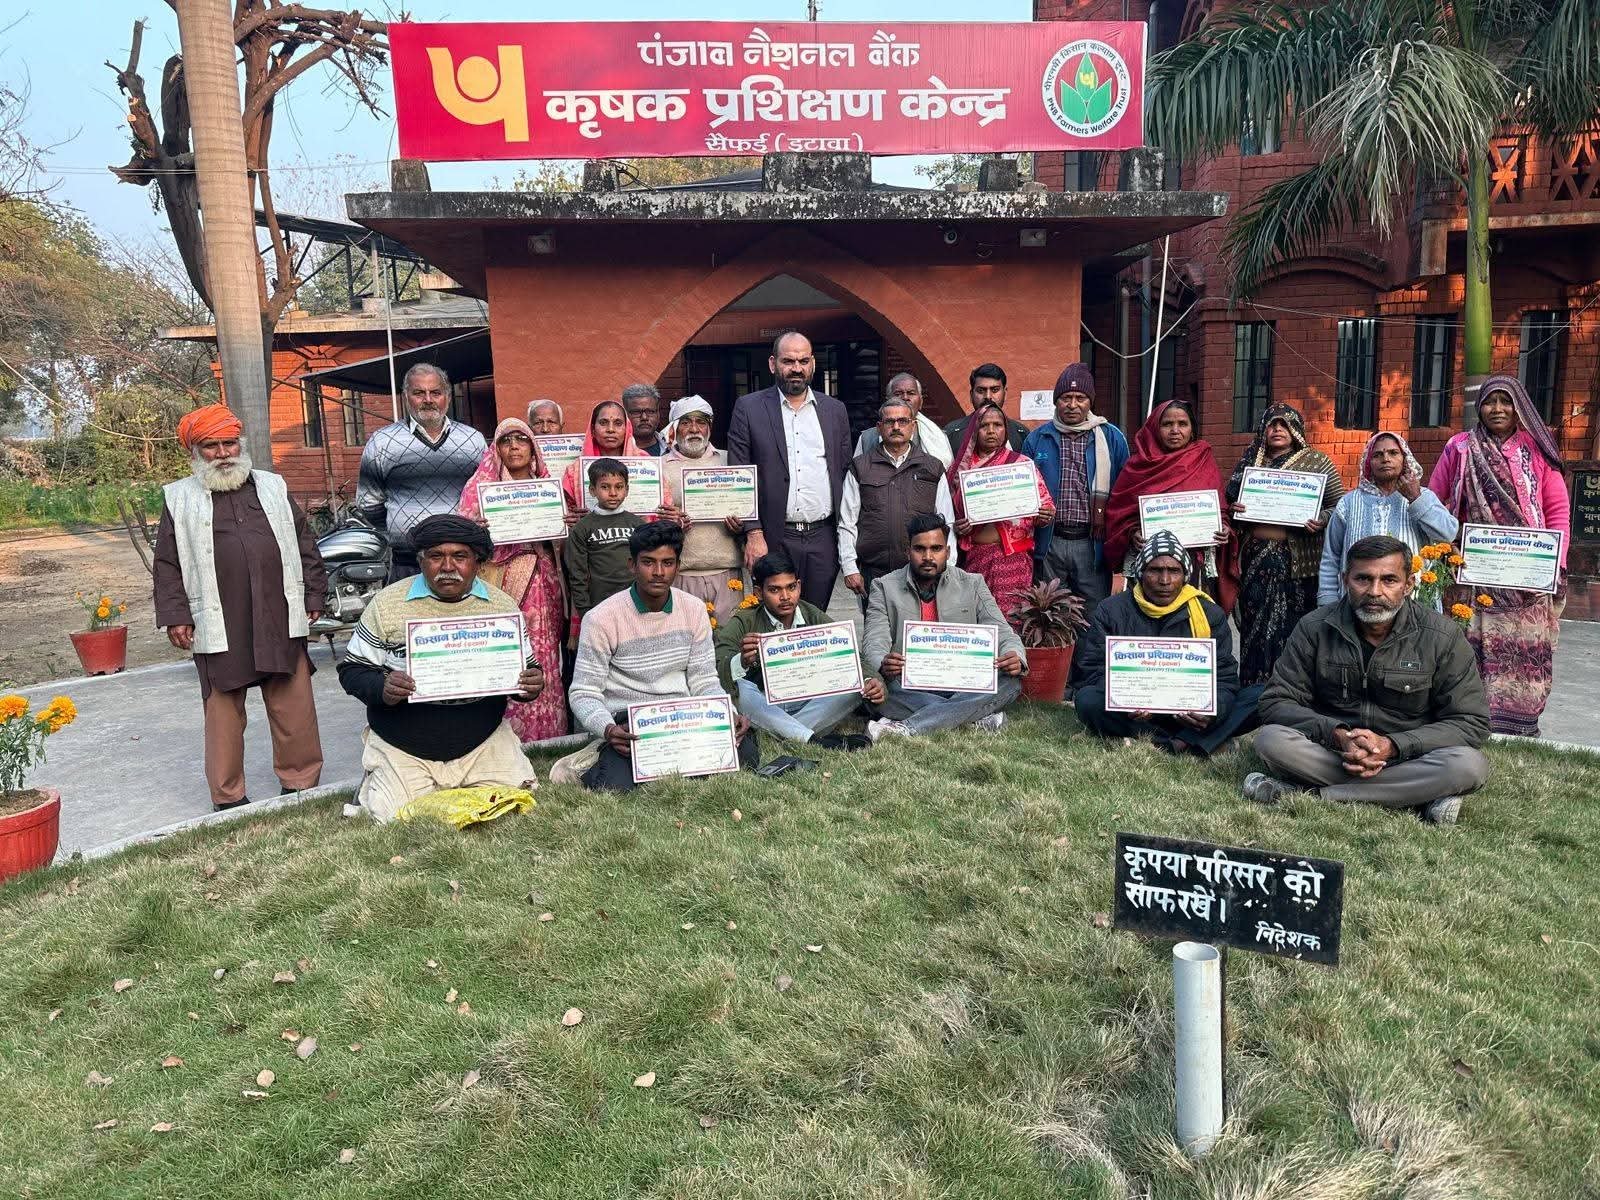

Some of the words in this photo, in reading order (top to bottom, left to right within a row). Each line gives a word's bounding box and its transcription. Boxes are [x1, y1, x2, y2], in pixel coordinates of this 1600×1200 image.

[636, 32, 734, 67] पंजाब
[742, 27, 855, 70] नैशनल
[868, 29, 920, 67] बैंक
[543, 88, 690, 138] कृषक
[702, 74, 887, 129] प्रशिक्षण
[898, 75, 1011, 127] केन्द्र
[1047, 98, 1058, 115] PNB
[1057, 116, 1088, 134] Farmers
[1091, 111, 1118, 133] Welfare
[1115, 88, 1127, 110] Trust
[588, 528, 635, 542] AMIR
[1123, 846, 1192, 880] कृपया
[1194, 850, 1275, 894] परिसर
[1283, 861, 1324, 898] को
[1125, 882, 1176, 914] साफ
[1255, 921, 1321, 952] निदेशक
